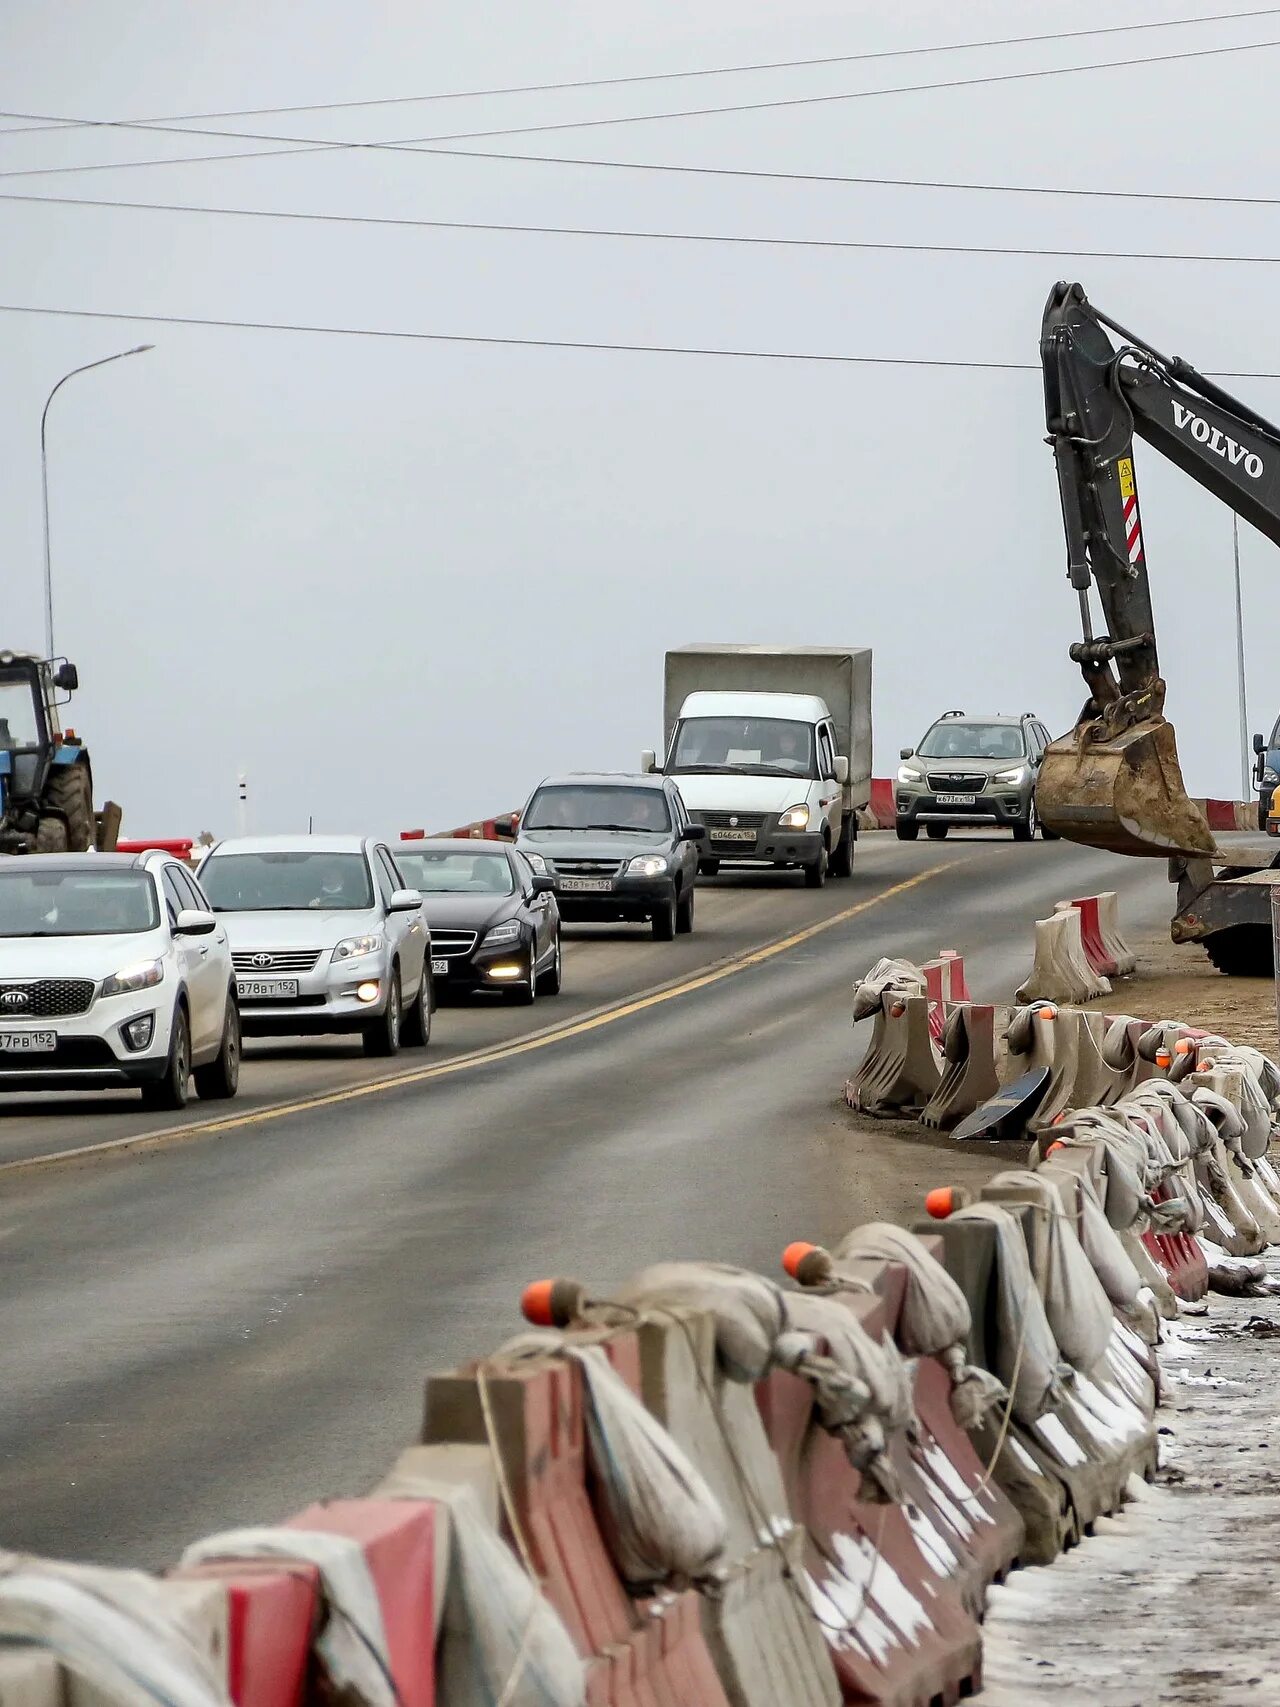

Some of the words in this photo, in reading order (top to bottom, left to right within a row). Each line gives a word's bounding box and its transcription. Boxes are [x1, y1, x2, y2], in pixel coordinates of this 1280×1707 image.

[1171, 399, 1264, 479] VOLVO
[277, 981, 294, 991] 152
[4, 994, 23, 1003] KIA
[32, 1033, 52, 1043] 152
